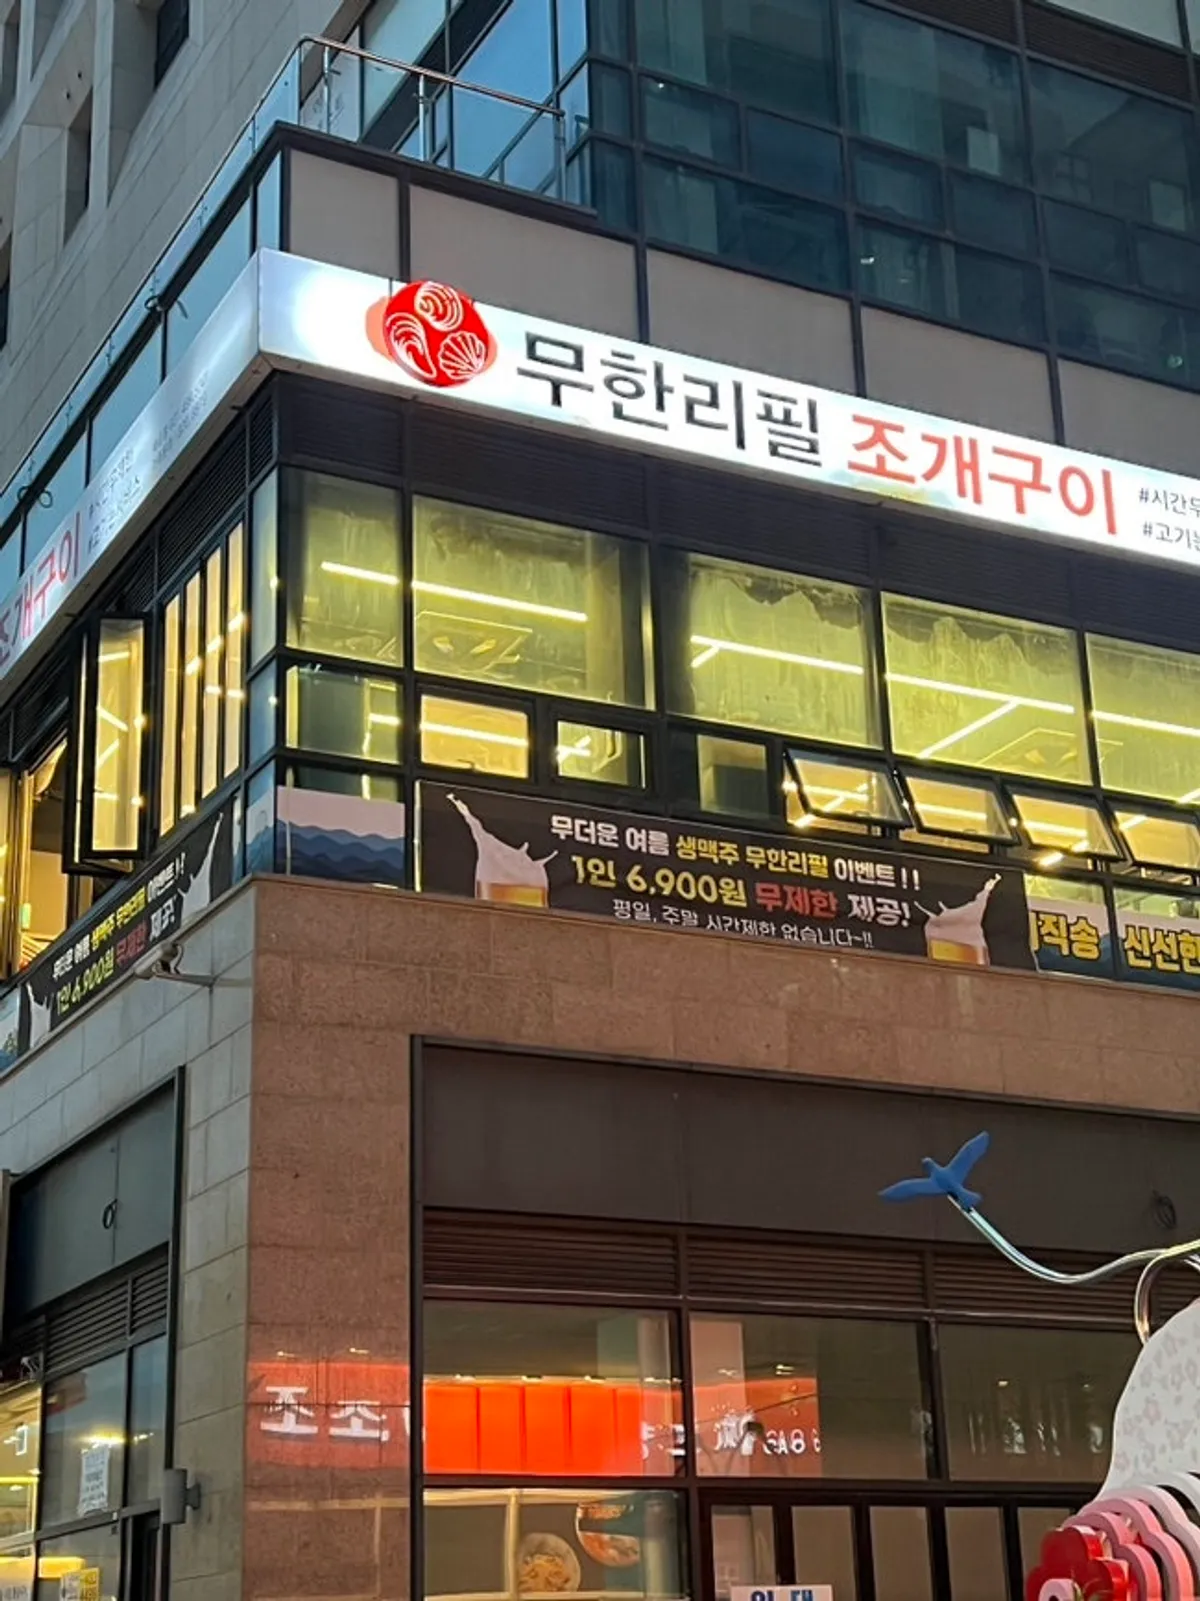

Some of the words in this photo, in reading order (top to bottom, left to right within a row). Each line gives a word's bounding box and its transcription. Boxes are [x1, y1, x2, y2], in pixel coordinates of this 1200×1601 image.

[516, 331, 822, 467] 무한리필
[847, 414, 1118, 536] 조개구이
[550, 814, 619, 849] 무더운
[625, 827, 670, 855] 여름
[675, 835, 740, 865] 생맥주
[745, 845, 829, 879] 무한리필
[834, 860, 896, 889] 이벤트
[571, 855, 617, 889] 1인
[754, 882, 838, 919] 무제한
[847, 893, 911, 928] 제공!
[612, 898, 657, 923] 평일,
[662, 904, 699, 928] 주말
[706, 914, 777, 938] 시간제한
